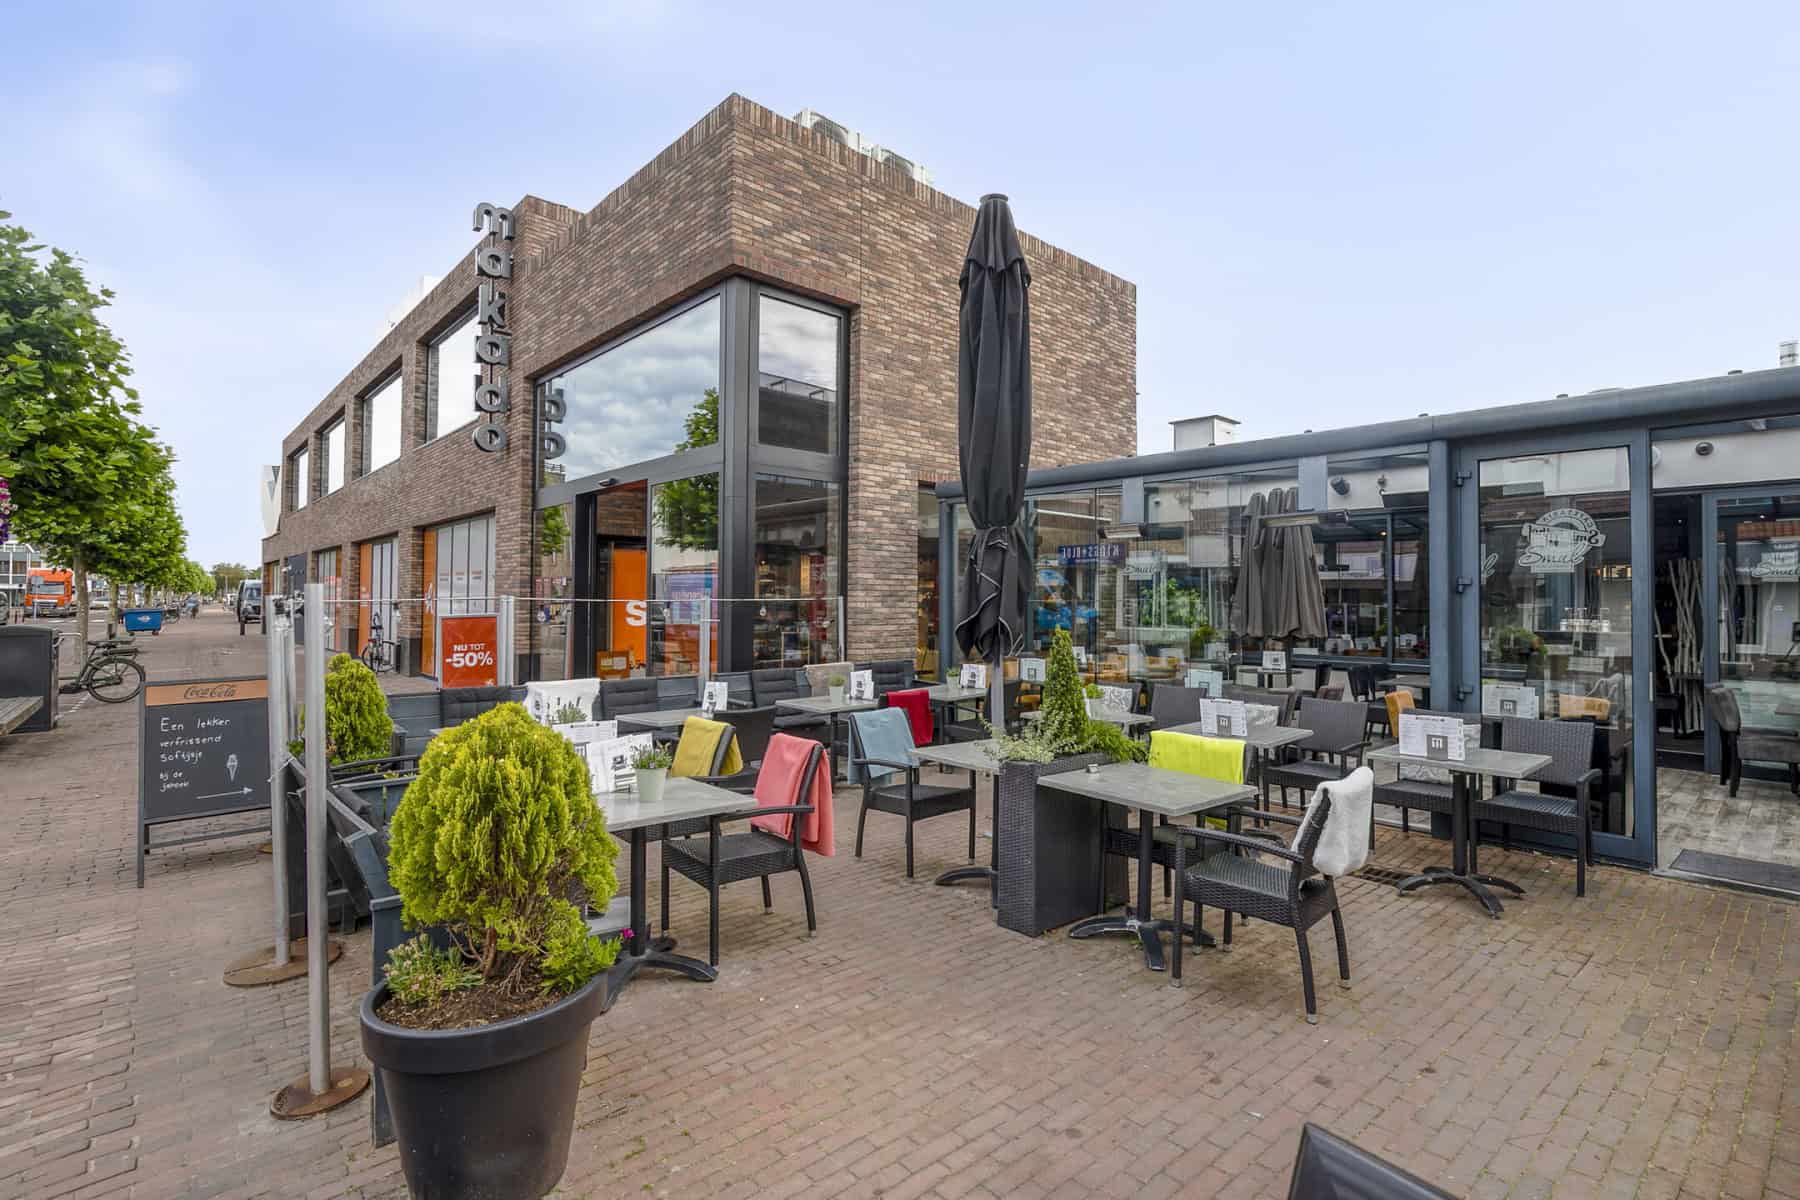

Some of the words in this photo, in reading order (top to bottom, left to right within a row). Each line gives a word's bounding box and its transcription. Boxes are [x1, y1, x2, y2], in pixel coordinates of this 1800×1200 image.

[472, 202, 515, 453] makado
[445, 651, 493, 668] -50%
[160, 717, 184, 732] Een
